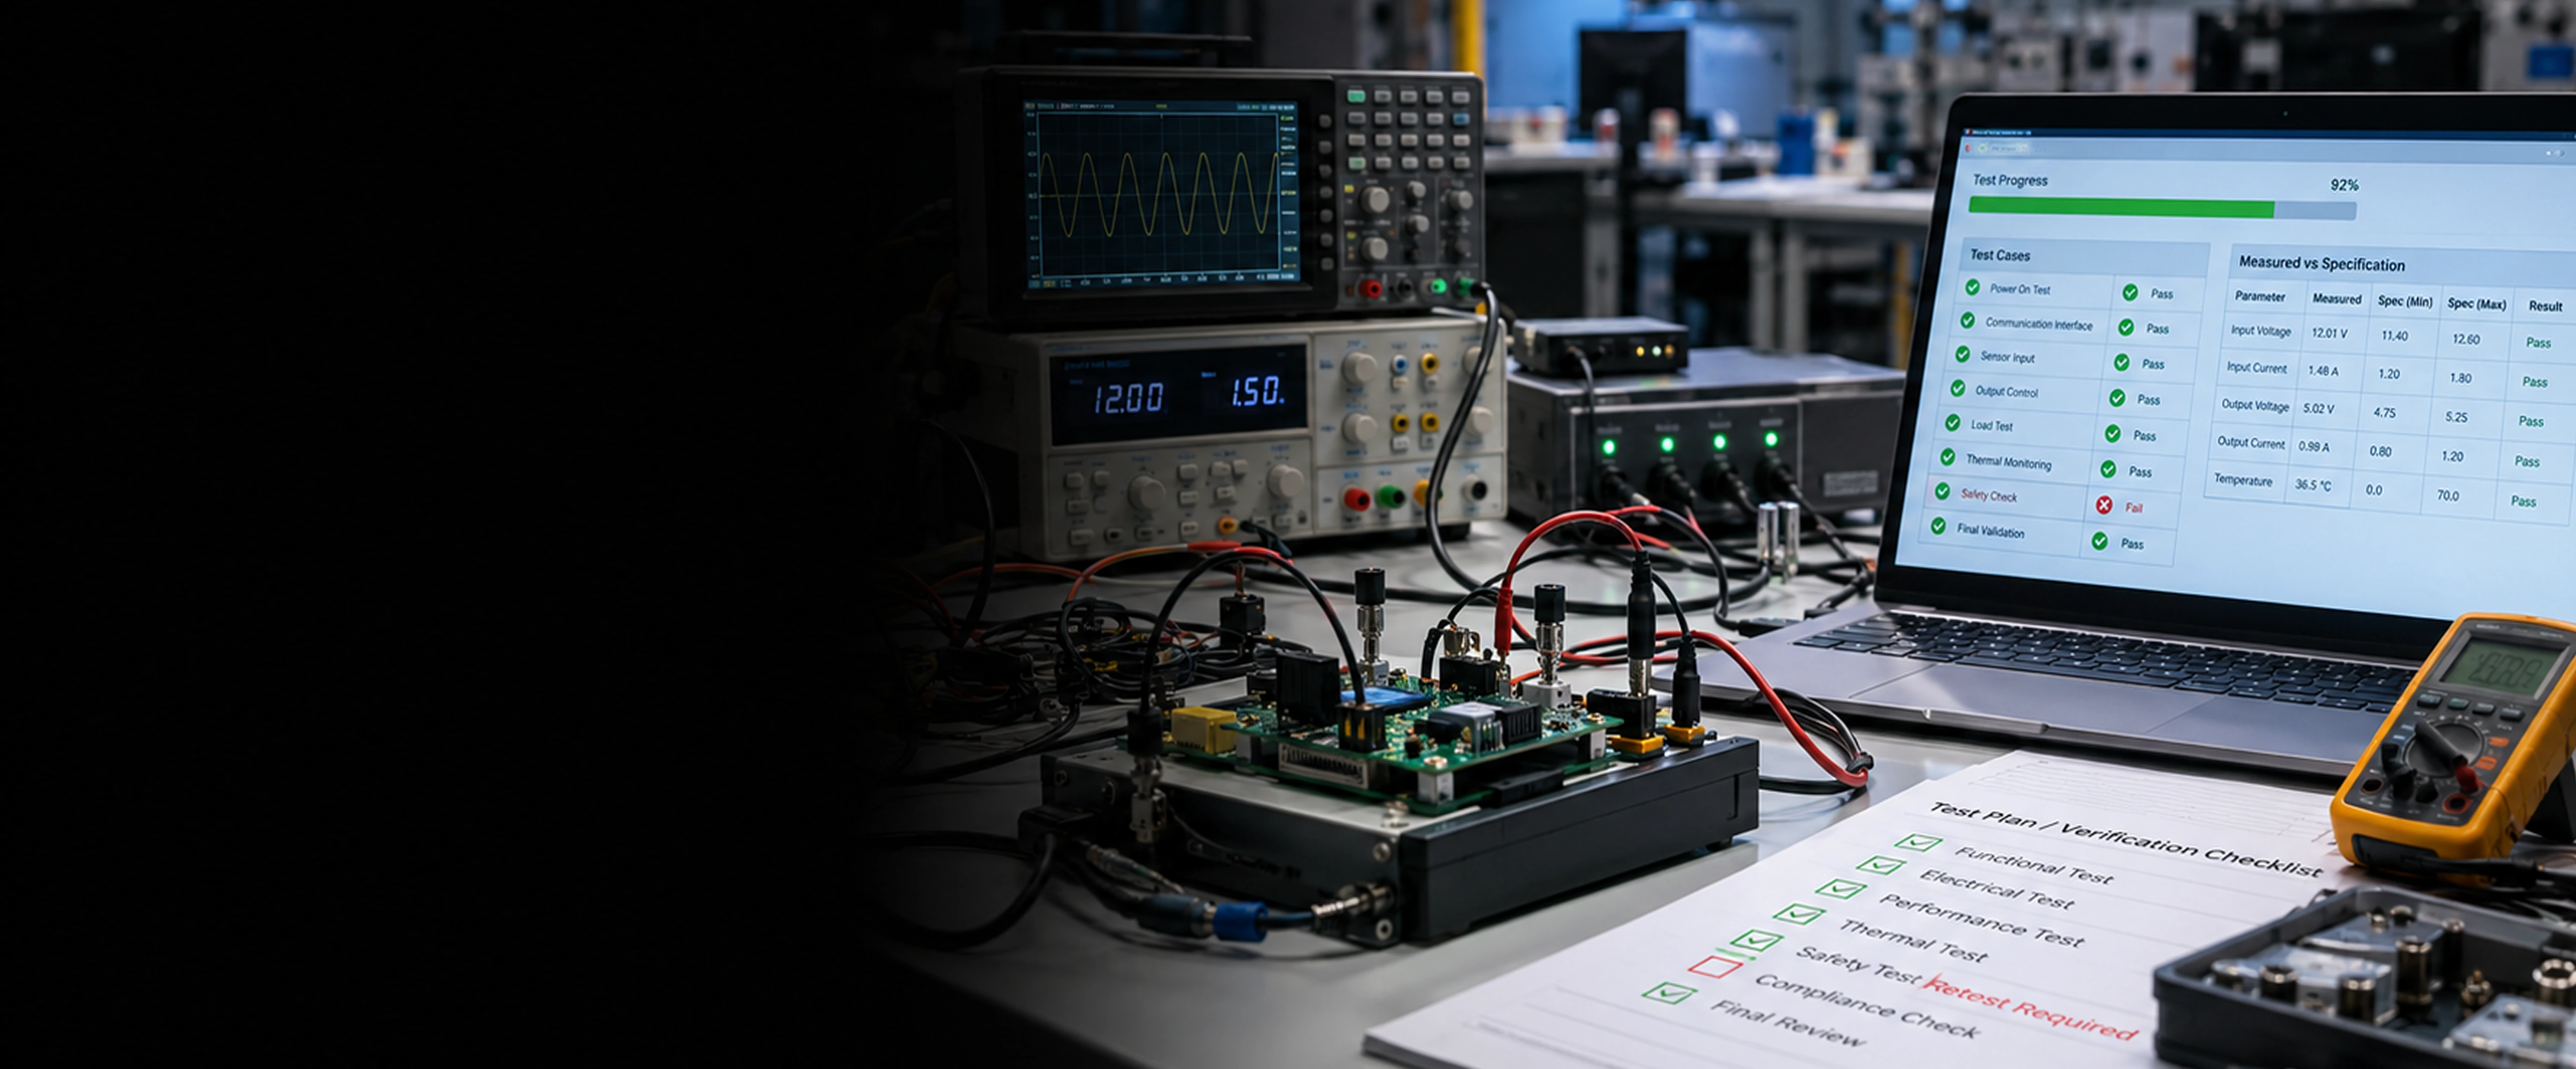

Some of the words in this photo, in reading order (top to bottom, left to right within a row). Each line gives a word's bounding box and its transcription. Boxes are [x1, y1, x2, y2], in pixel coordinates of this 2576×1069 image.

[1974, 174, 1996, 186] Test
[1998, 174, 2048, 189] Progress
[2331, 179, 2360, 191] 92%
[1970, 248, 1994, 261] Test
[1997, 249, 2031, 262] Cases
[2239, 255, 2301, 269] Measured
[2304, 259, 2318, 269] vs
[2322, 257, 2405, 272] Specification
[1990, 283, 2016, 295] Power
[2018, 284, 2031, 295] On
[2033, 285, 2050, 295] Test
[2151, 288, 2174, 300] Pass
[2235, 290, 2286, 303] Parameter
[2313, 293, 2362, 305] Measured
[2378, 295, 2403, 308] Spec
[2407, 296, 2433, 309] (Min)
[2448, 297, 2473, 311] Spec
[2476, 299, 2507, 312] (Max)
[2529, 301, 2563, 312] Result
[1986, 317, 2053, 329] Communication
[2054, 319, 2093, 331] Interface
[2146, 323, 2169, 335] Pass
[2231, 325, 2255, 336] Input
[2257, 326, 2292, 339] Voltage
[2312, 327, 2337, 338] 12.01
[2340, 328, 2348, 338] V
[2382, 330, 2408, 342] 11.40
[2453, 334, 2480, 345] 12.60
[2527, 337, 2552, 349] Pass
[1981, 351, 2010, 362] Sensor
[2013, 353, 2035, 365] Input
[2142, 359, 2165, 370] Pass
[2227, 361, 2251, 373] Input
[2252, 362, 2288, 374] Current
[2309, 365, 2329, 376] 1.48
[2331, 367, 2339, 376] A
[2379, 369, 2400, 379] 1.20
[2450, 373, 2472, 383] 1.80
[2523, 376, 2548, 388] Pass
[1095, 382, 1163, 414] 12.00
[1976, 385, 2005, 398] Output
[2007, 387, 2039, 399] Control
[2137, 394, 2160, 406] Pass
[2222, 398, 2253, 411] Output
[2255, 400, 2290, 414] Voltage
[2304, 403, 2325, 414] 5.02
[2327, 405, 2335, 415] V
[2374, 407, 2396, 419] 4.75
[2445, 411, 2468, 423] 5.25
[2519, 415, 2544, 427] Pass
[1971, 419, 1993, 431] Load
[1996, 421, 2013, 431] Test
[2134, 430, 2156, 442] Pass
[2217, 435, 2248, 448] Output
[2250, 438, 2285, 450] Current
[2322, 443, 2330, 452] A
[2370, 445, 2392, 457] 0.80
[2442, 450, 2464, 462] 1.20
[2515, 455, 2540, 468] Pass
[1967, 454, 2002, 466] Thermal
[2004, 458, 2052, 472] Monitoring
[2129, 466, 2152, 478] Pass
[2215, 472, 2272, 487] Temperature
[2295, 478, 2317, 491] 36.5
[1961, 488, 1988, 502] Safety
[1991, 490, 2017, 503] Check
[2366, 484, 2383, 495] 0.0
[2437, 489, 2460, 502] 70.0
[2126, 502, 2143, 513] Fail
[2511, 495, 2536, 508] Pass
[1958, 523, 1979, 534] Final
[1982, 525, 2025, 539] Validation
[2121, 538, 2144, 550] Pass
[1930, 801, 1981, 818] Test
[1982, 811, 2038, 829] Plan
[2061, 823, 2199, 856] Verification
[2204, 848, 2325, 878] Checklist
[1955, 846, 2066, 875] Functional
[2069, 867, 2115, 886] Test
[1920, 870, 2024, 899] Electrical
[2026, 891, 2077, 911] Test
[1879, 893, 2028, 935] Performance
[2034, 927, 2086, 949] Test
[1840, 918, 1937, 951] Thermal
[1940, 942, 1990, 964] Test
[1796, 945, 1872, 973] Safety
[1874, 963, 1923, 985] Test
[1755, 973, 1897, 1018] Compliance
[1900, 1011, 1982, 1040] Check
[1710, 999, 1776, 1024] Final
[1773, 1016, 1868, 1048] Review
[2012, 1002, 2140, 1041] Required
